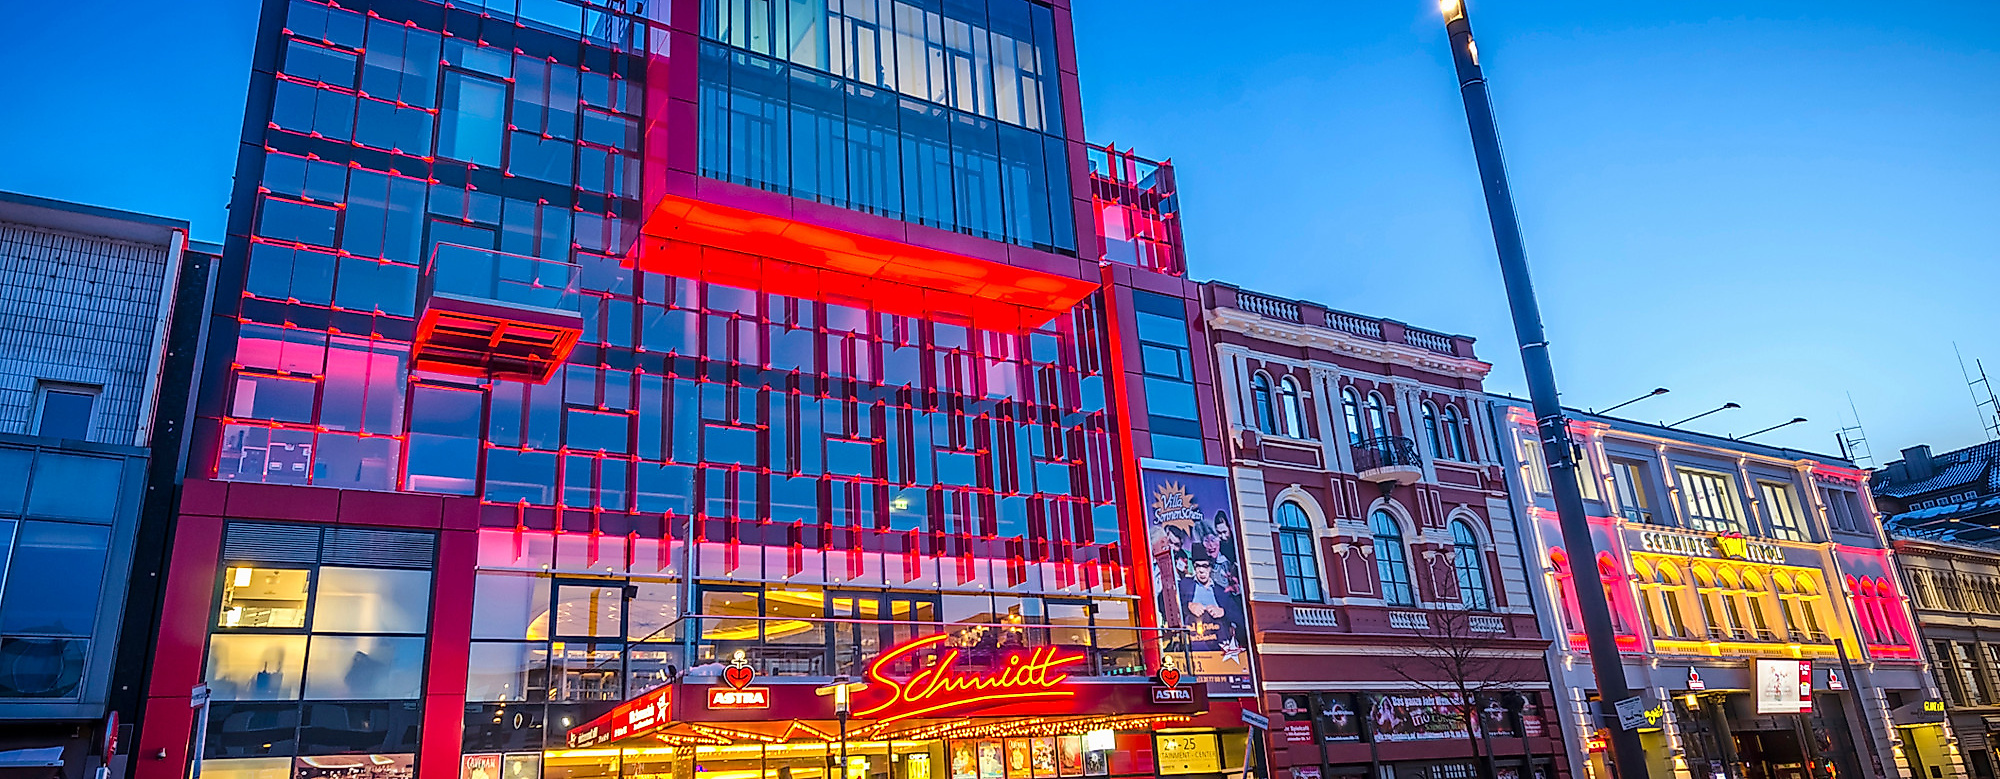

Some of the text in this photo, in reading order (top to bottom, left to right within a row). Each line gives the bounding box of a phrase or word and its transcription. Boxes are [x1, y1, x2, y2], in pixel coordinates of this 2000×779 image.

[853, 634, 1084, 717] Schmidt
[712, 692, 765, 704] ASTRA
[1155, 690, 1191, 699] ASTRA
